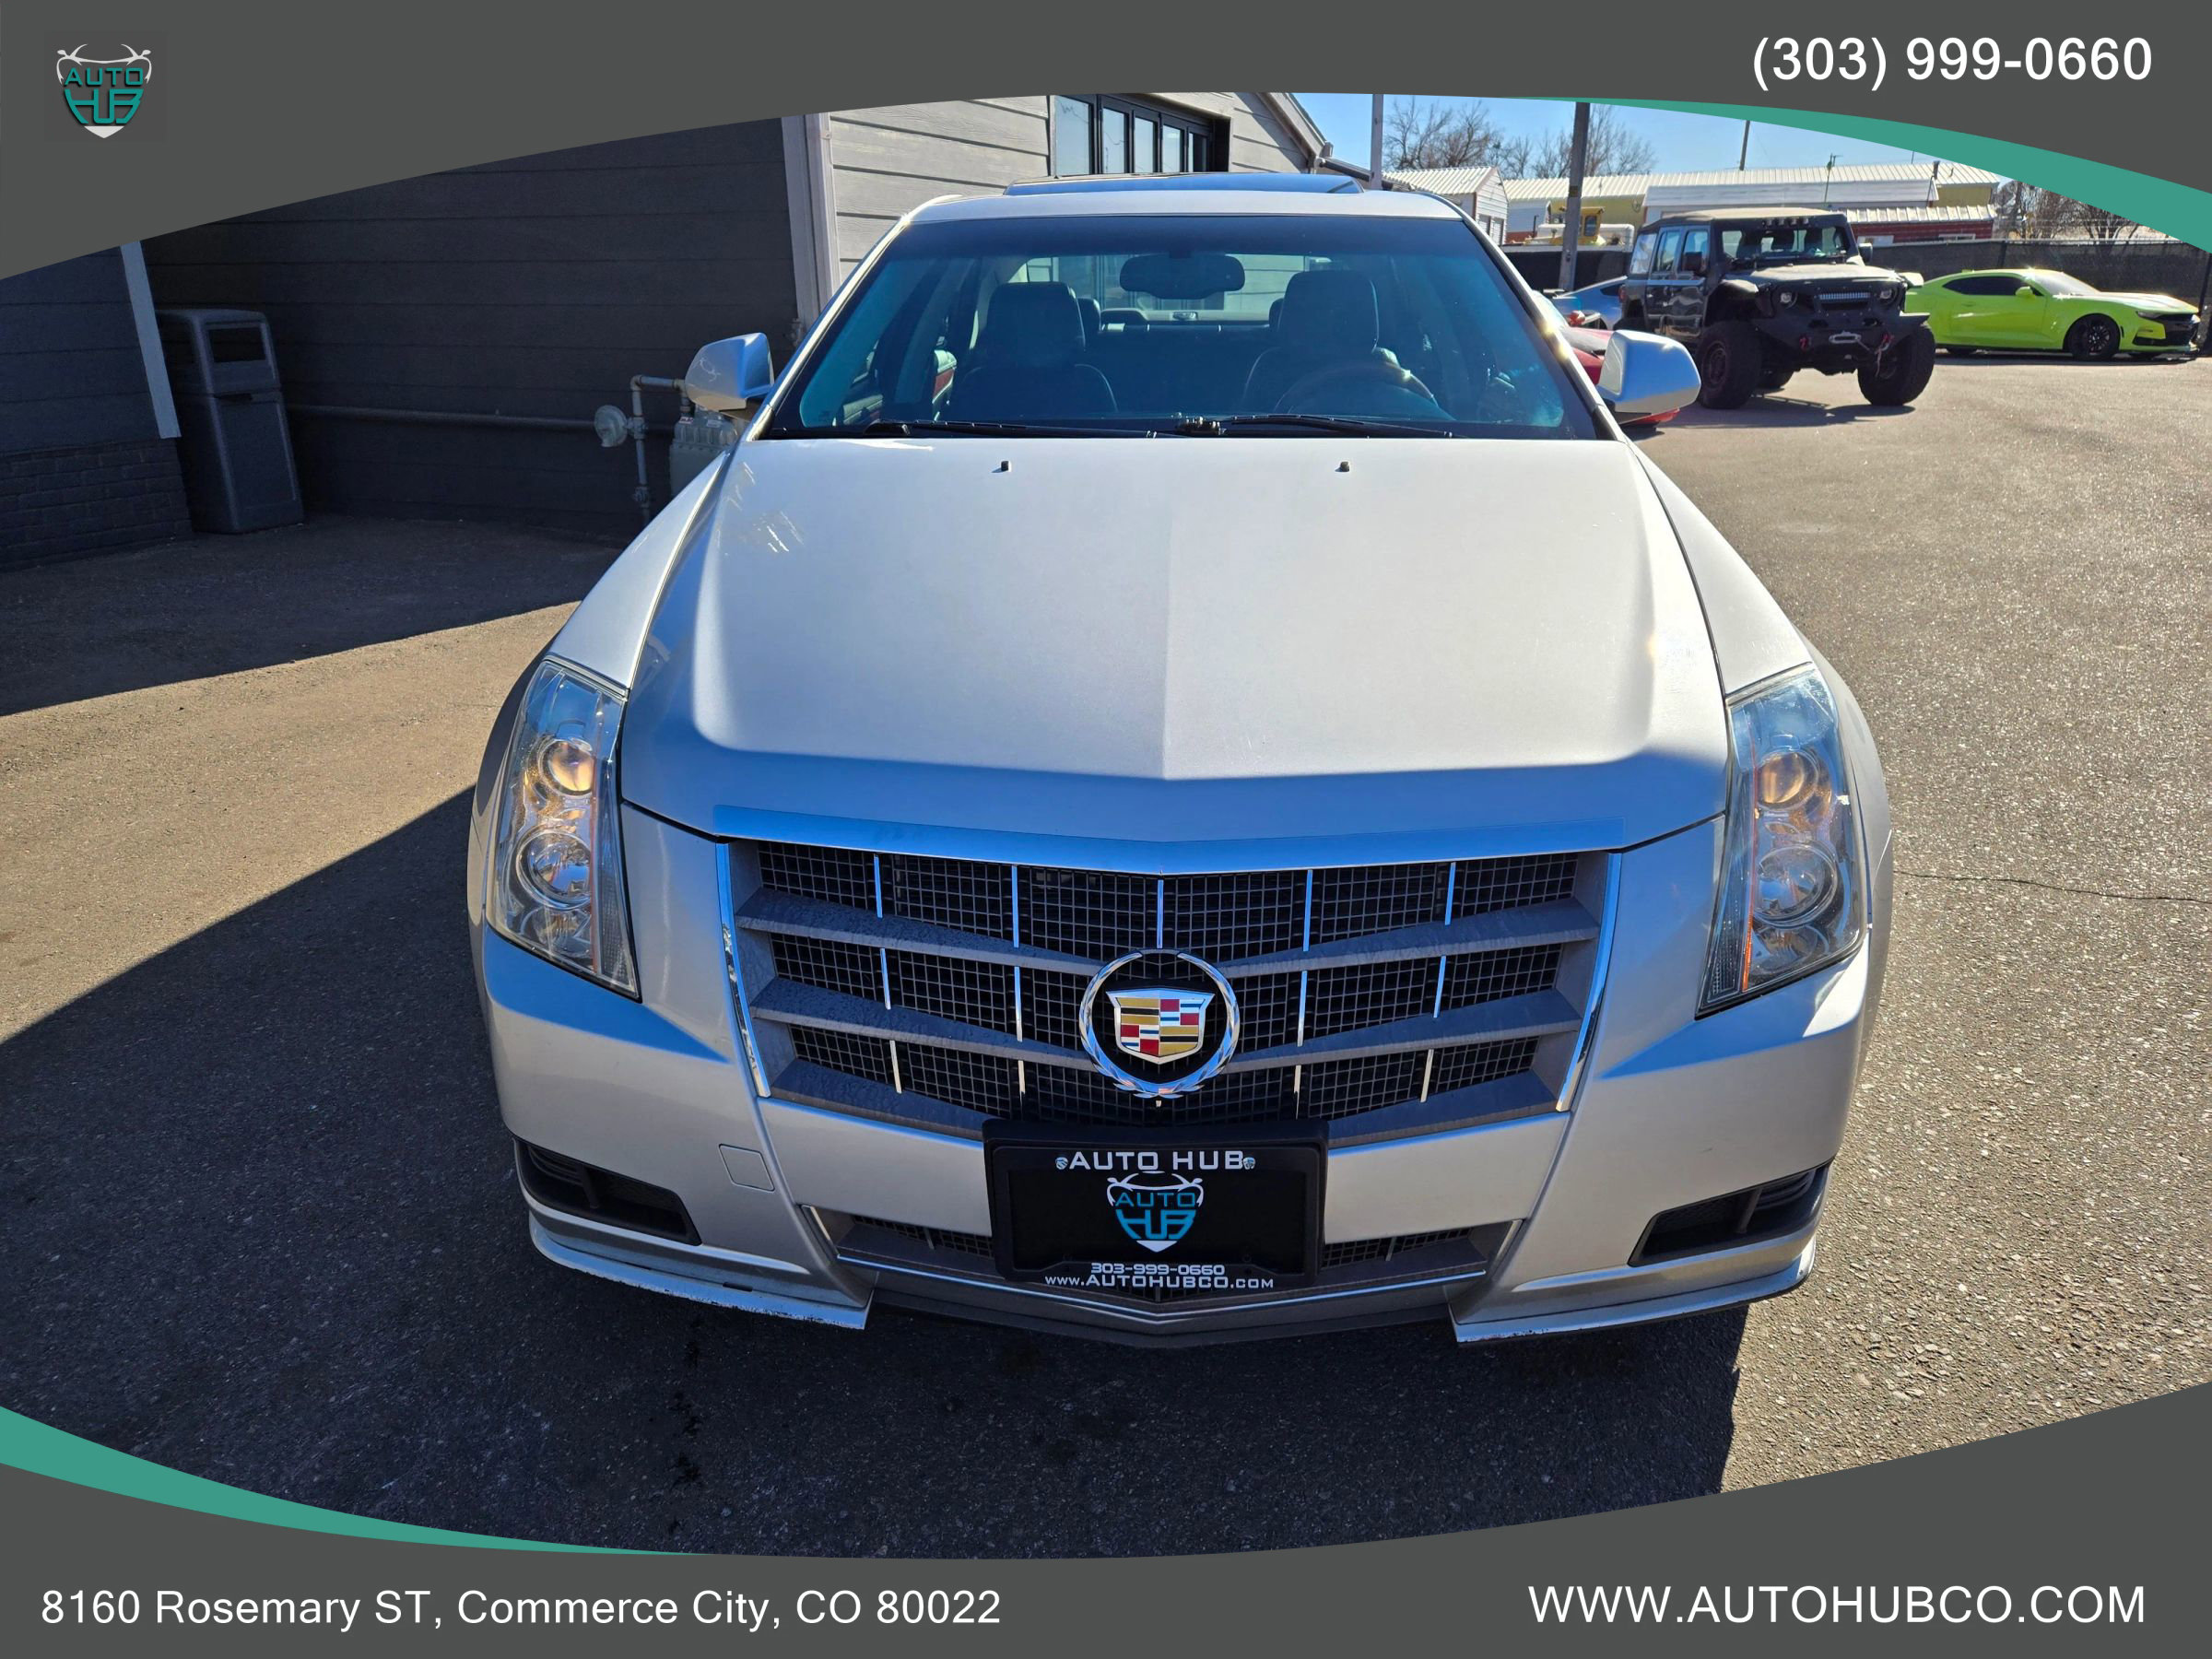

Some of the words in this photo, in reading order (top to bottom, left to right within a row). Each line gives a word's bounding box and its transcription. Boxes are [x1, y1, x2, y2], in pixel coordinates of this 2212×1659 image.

[1069, 1151, 1159, 1171] AUTO
[1172, 1150, 1244, 1171] HUB
[1114, 1192, 1196, 1207] AUTO
[1115, 1208, 1196, 1240] HUB
[1090, 1262, 1225, 1276] 303-999-0660
